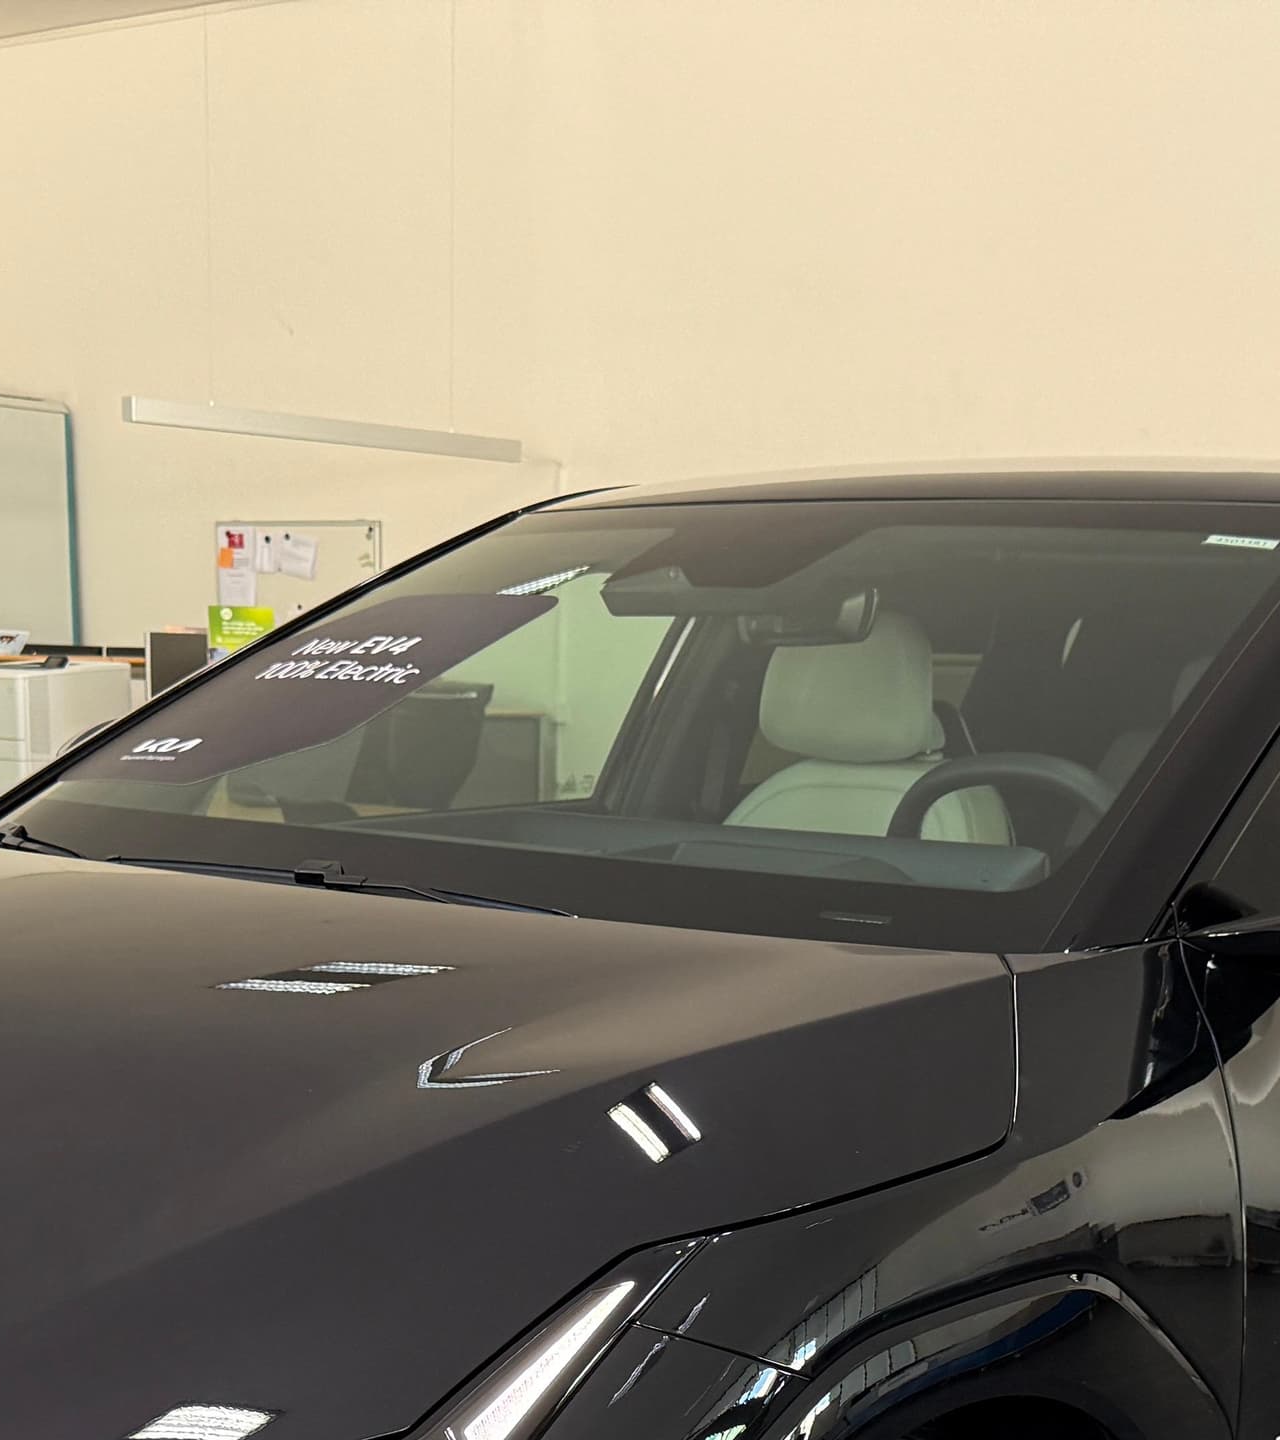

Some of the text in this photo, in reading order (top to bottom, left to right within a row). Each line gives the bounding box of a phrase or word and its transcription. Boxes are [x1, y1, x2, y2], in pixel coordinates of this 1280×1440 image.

[292, 636, 422, 656] New EV4
[255, 659, 420, 685] 100% Electric
